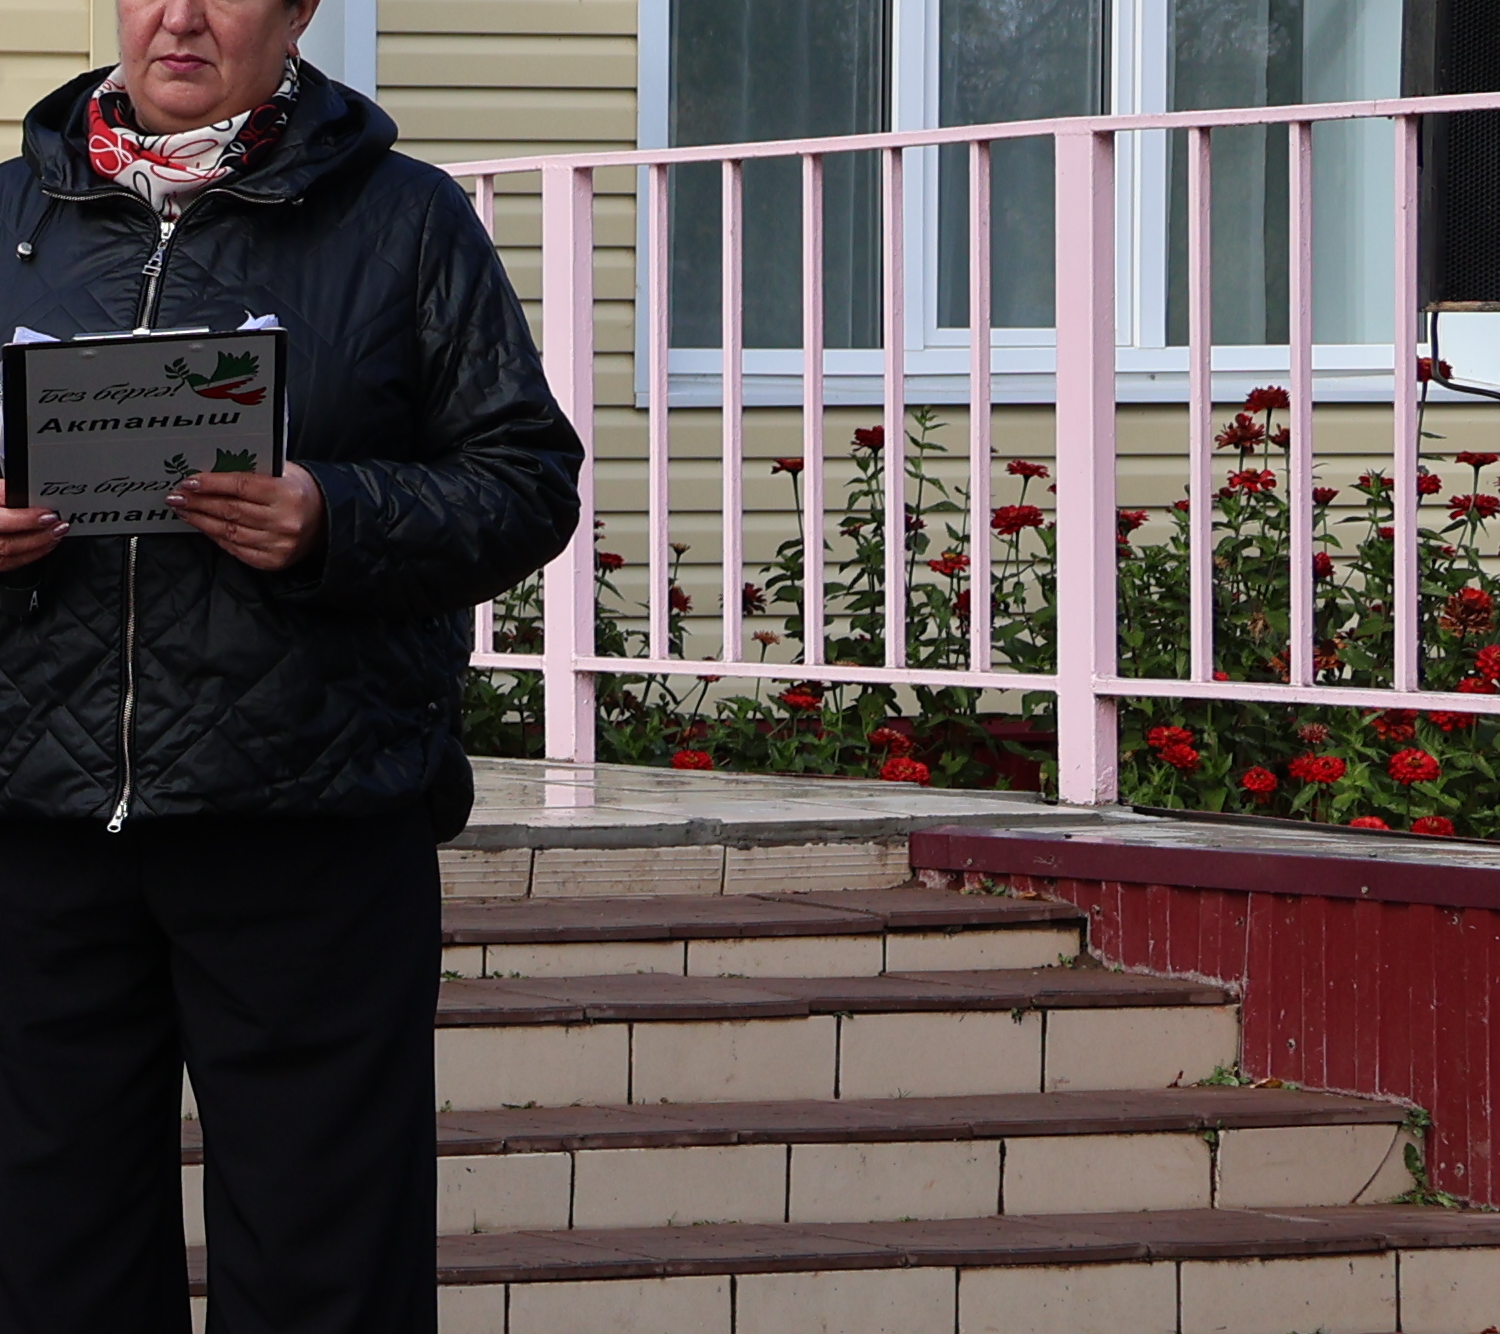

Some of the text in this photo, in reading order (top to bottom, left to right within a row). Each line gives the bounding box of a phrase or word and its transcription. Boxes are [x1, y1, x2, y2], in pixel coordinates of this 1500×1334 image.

[38, 380, 184, 407] Без бергә!
[37, 412, 241, 435] Актаныш
[40, 481, 88, 497] Без
[52, 509, 182, 525] ктан
